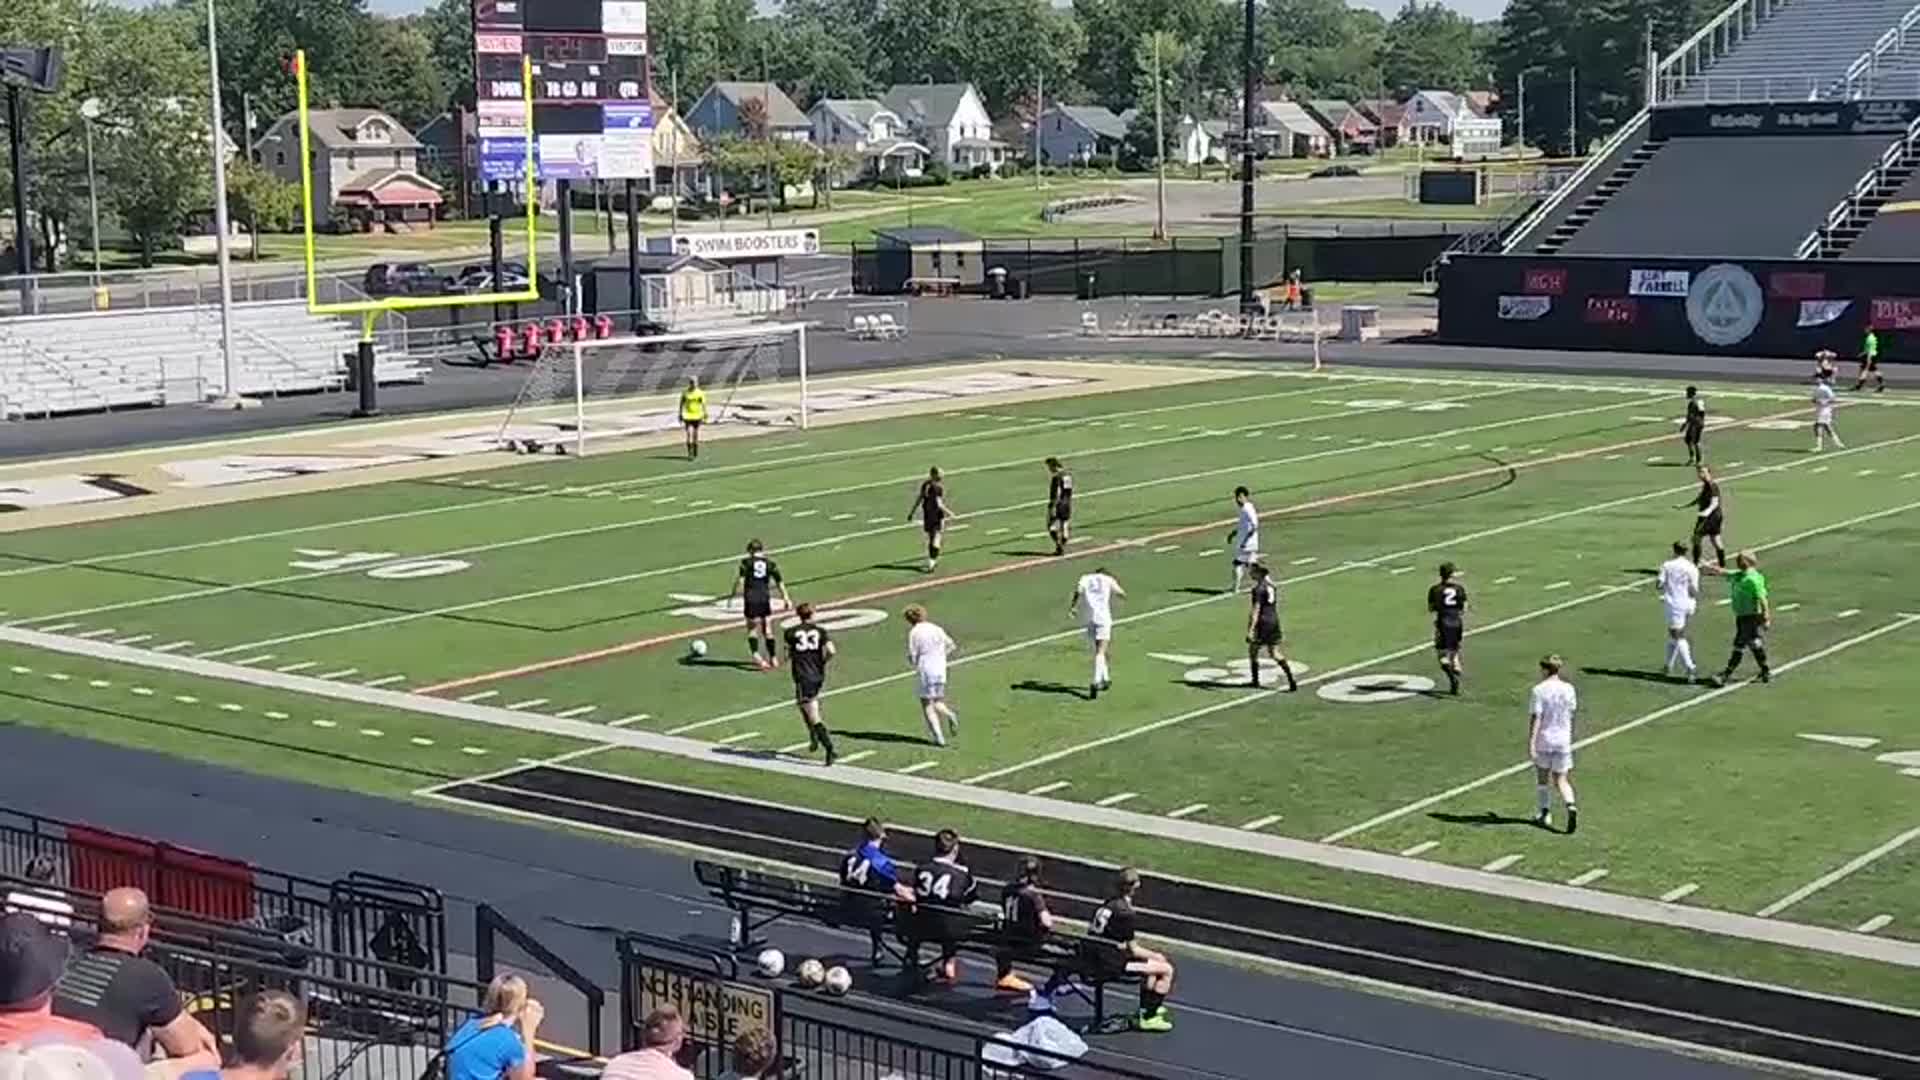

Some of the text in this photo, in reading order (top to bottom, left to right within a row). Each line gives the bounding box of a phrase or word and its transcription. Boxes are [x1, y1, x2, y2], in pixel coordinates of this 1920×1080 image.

[695, 235, 799, 252] SWIM BOOSTERS
[1443, 588, 1457, 605] 2
[794, 630, 821, 651] 33
[846, 856, 871, 885] 14
[916, 872, 952, 900] 34
[672, 980, 763, 1019] STANDING
